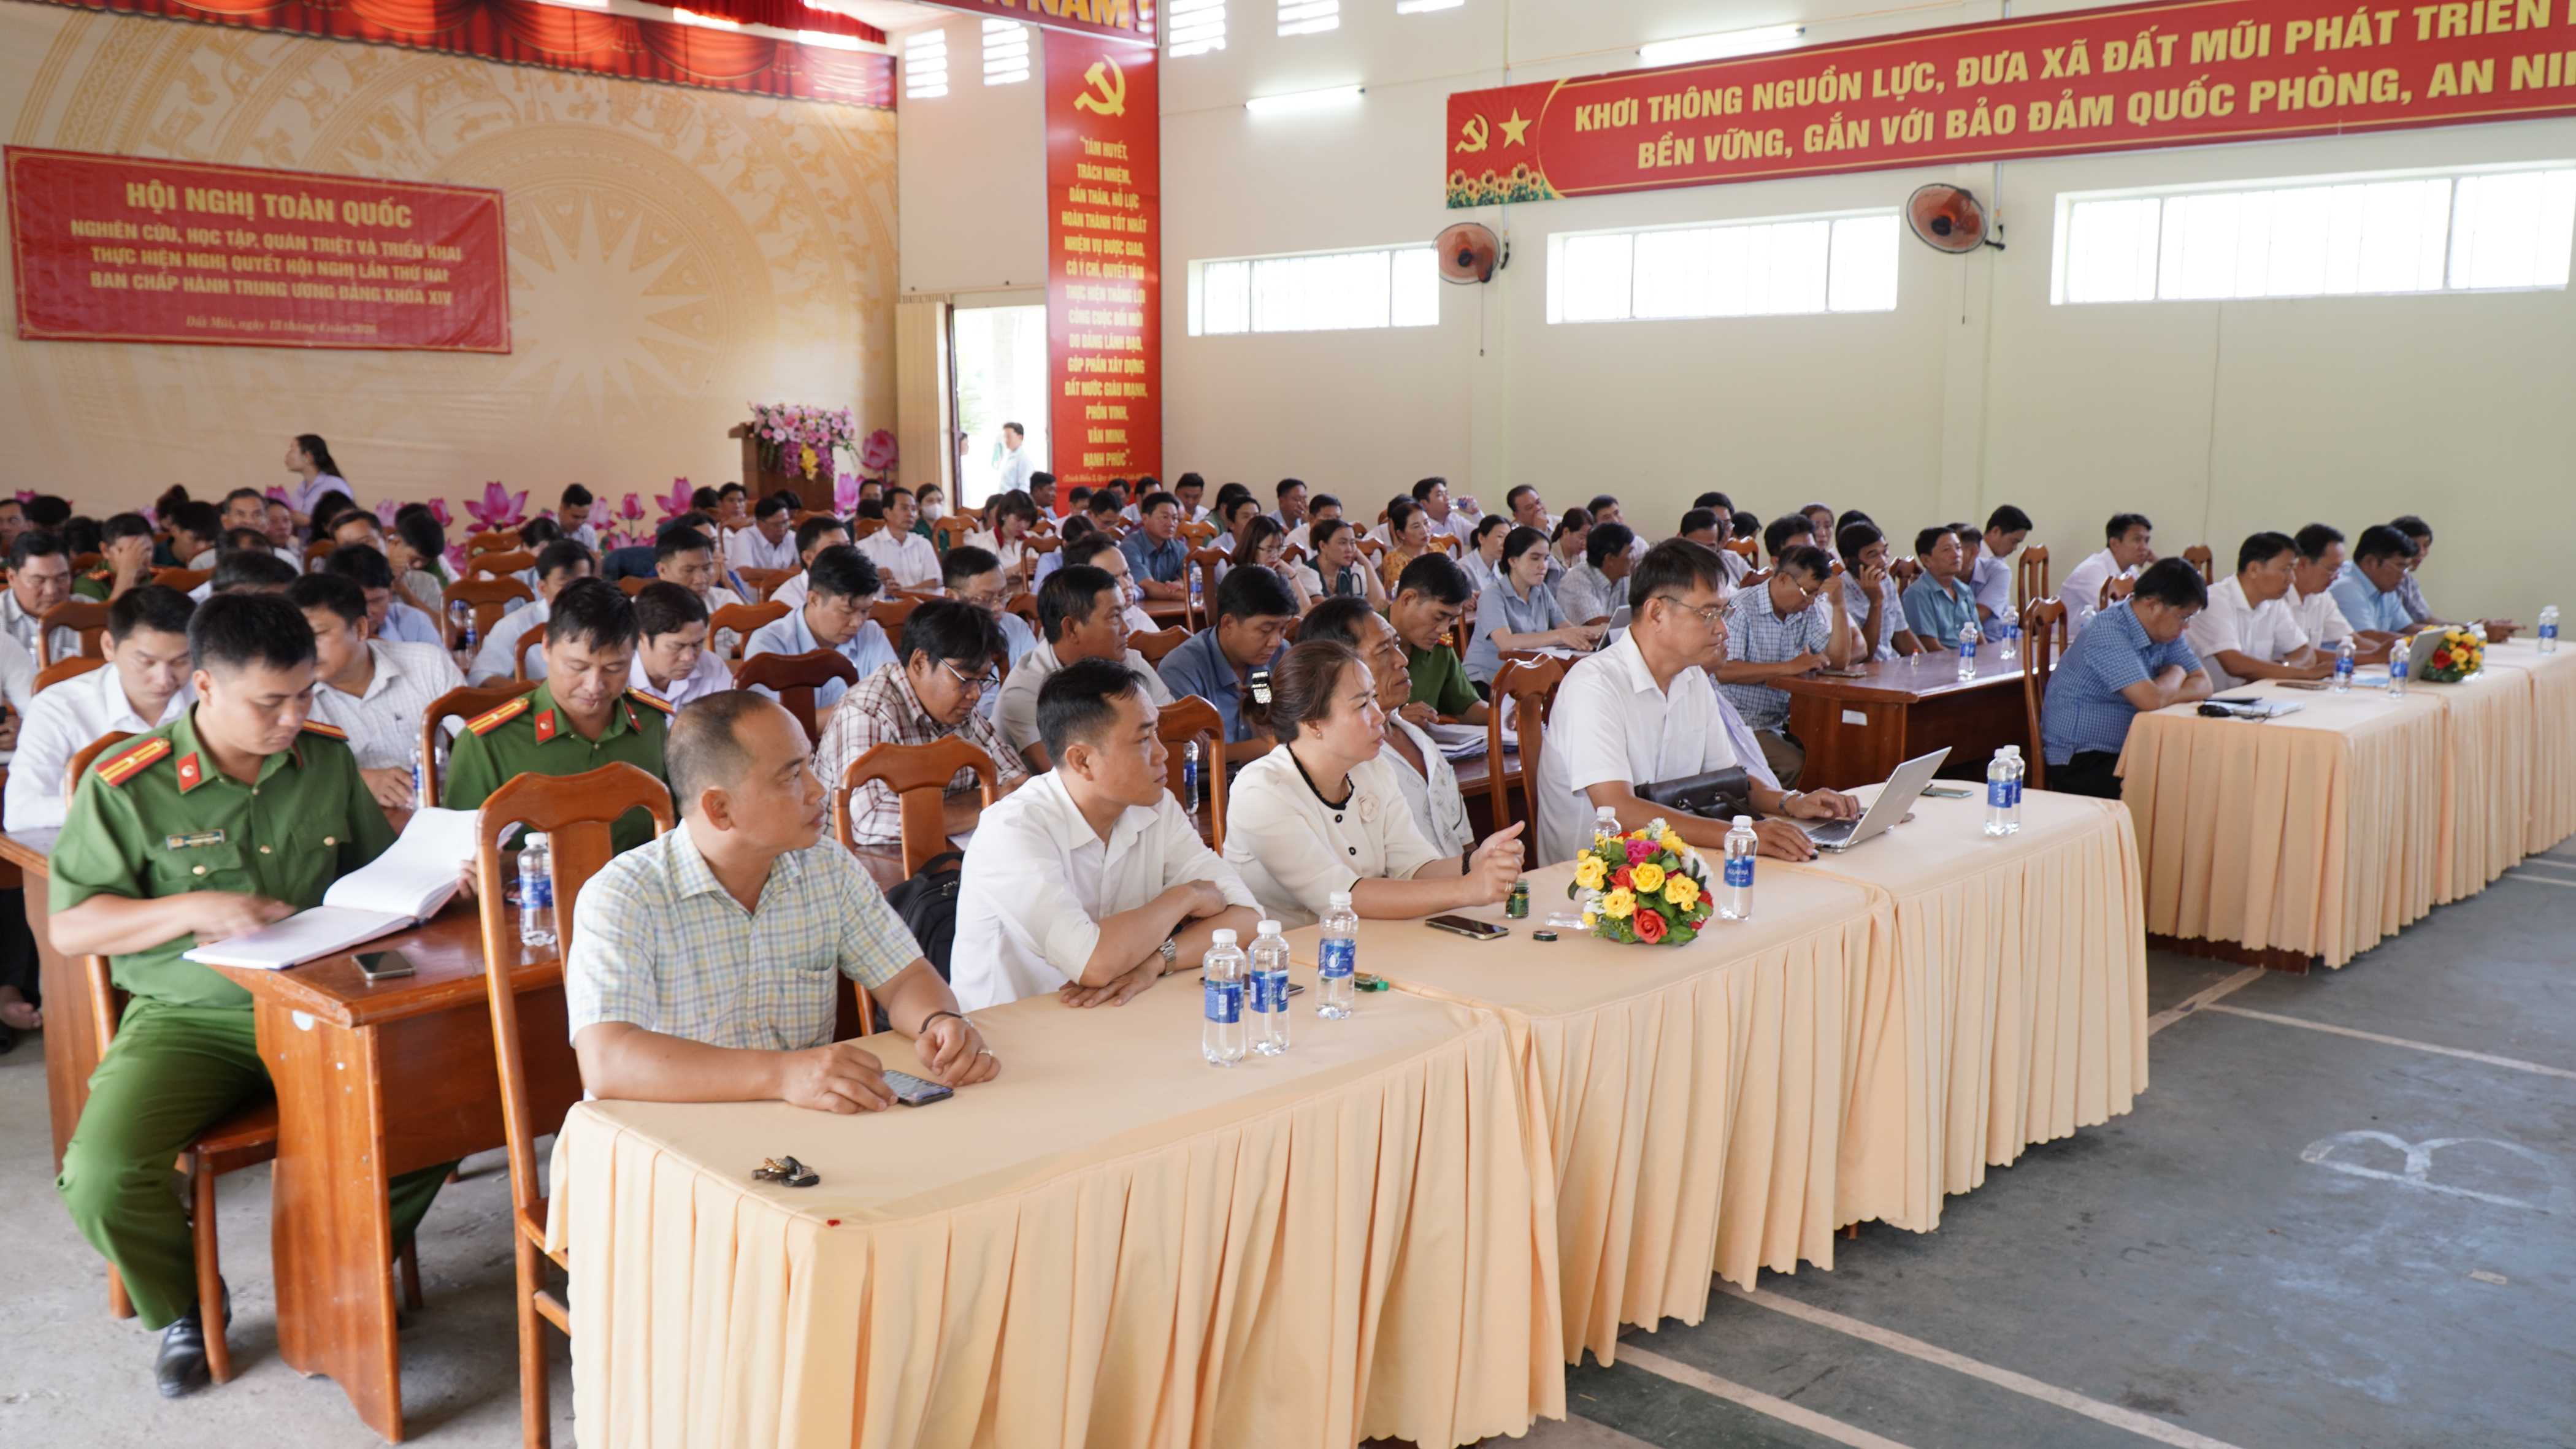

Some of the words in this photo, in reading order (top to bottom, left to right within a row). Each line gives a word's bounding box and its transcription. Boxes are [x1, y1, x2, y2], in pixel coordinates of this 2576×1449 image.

[1574, 96, 1639, 132] KHƠI
[1647, 85, 1742, 123] THÔNG
[1752, 65, 1863, 111] NGUỒN
[1873, 60, 1945, 102] LỰC,
[1957, 50, 2028, 88] ĐƯA
[2039, 39, 2091, 79] XÃ
[2103, 25, 2179, 74] ĐẤT
[2190, 19, 2271, 64] MŨI
[2285, 6, 2399, 55] PHÁT
[1638, 131, 1695, 170] BỀN
[1704, 128, 1793, 162] VỮNG,
[1804, 112, 1871, 153] GẮN
[1881, 108, 1935, 146] VỚI
[1945, 96, 2017, 140] BẢO
[2028, 88, 2115, 132] ĐẢM
[2126, 74, 2236, 126] QUỐC
[2248, 66, 2413, 115] PHÒNG,
[2426, 58, 2496, 98] AN
[1077, 162, 1102, 181] TRÁCH
[126, 178, 177, 214] HỘI
[185, 186, 255, 221] NGHỊ
[262, 191, 334, 223] TOÀN
[343, 196, 413, 229] QUỐC
[1062, 209, 1084, 227] HOÀN
[1086, 212, 1111, 230] THÀNH
[1127, 214, 1147, 233] NHẤT
[71, 219, 138, 240] NGHIÊN
[186, 227, 221, 248] HỌC
[312, 235, 354, 256] TRIỆT
[356, 238, 378, 255] VÀ
[381, 238, 424, 259] TRIỂN
[427, 245, 462, 262] KHAI
[92, 247, 137, 267] THỰC
[141, 248, 182, 270] HIỆN
[186, 252, 228, 272] NGHỊ
[231, 253, 282, 273] QUYẾT
[286, 256, 313, 277] HỘI
[318, 260, 355, 280] NGHỊ
[358, 259, 389, 280] LẦN
[392, 263, 421, 281] THỨ
[424, 268, 450, 283] HAI
[91, 270, 128, 289] BAN
[132, 271, 178, 291] CHẤP
[183, 274, 230, 294] HÀNH
[234, 278, 287, 297] TRUNG
[291, 281, 334, 299] ƯƠNG
[339, 282, 380, 302] ĐẢNG
[385, 288, 424, 304] KHÓA
[428, 290, 452, 306] XIV
